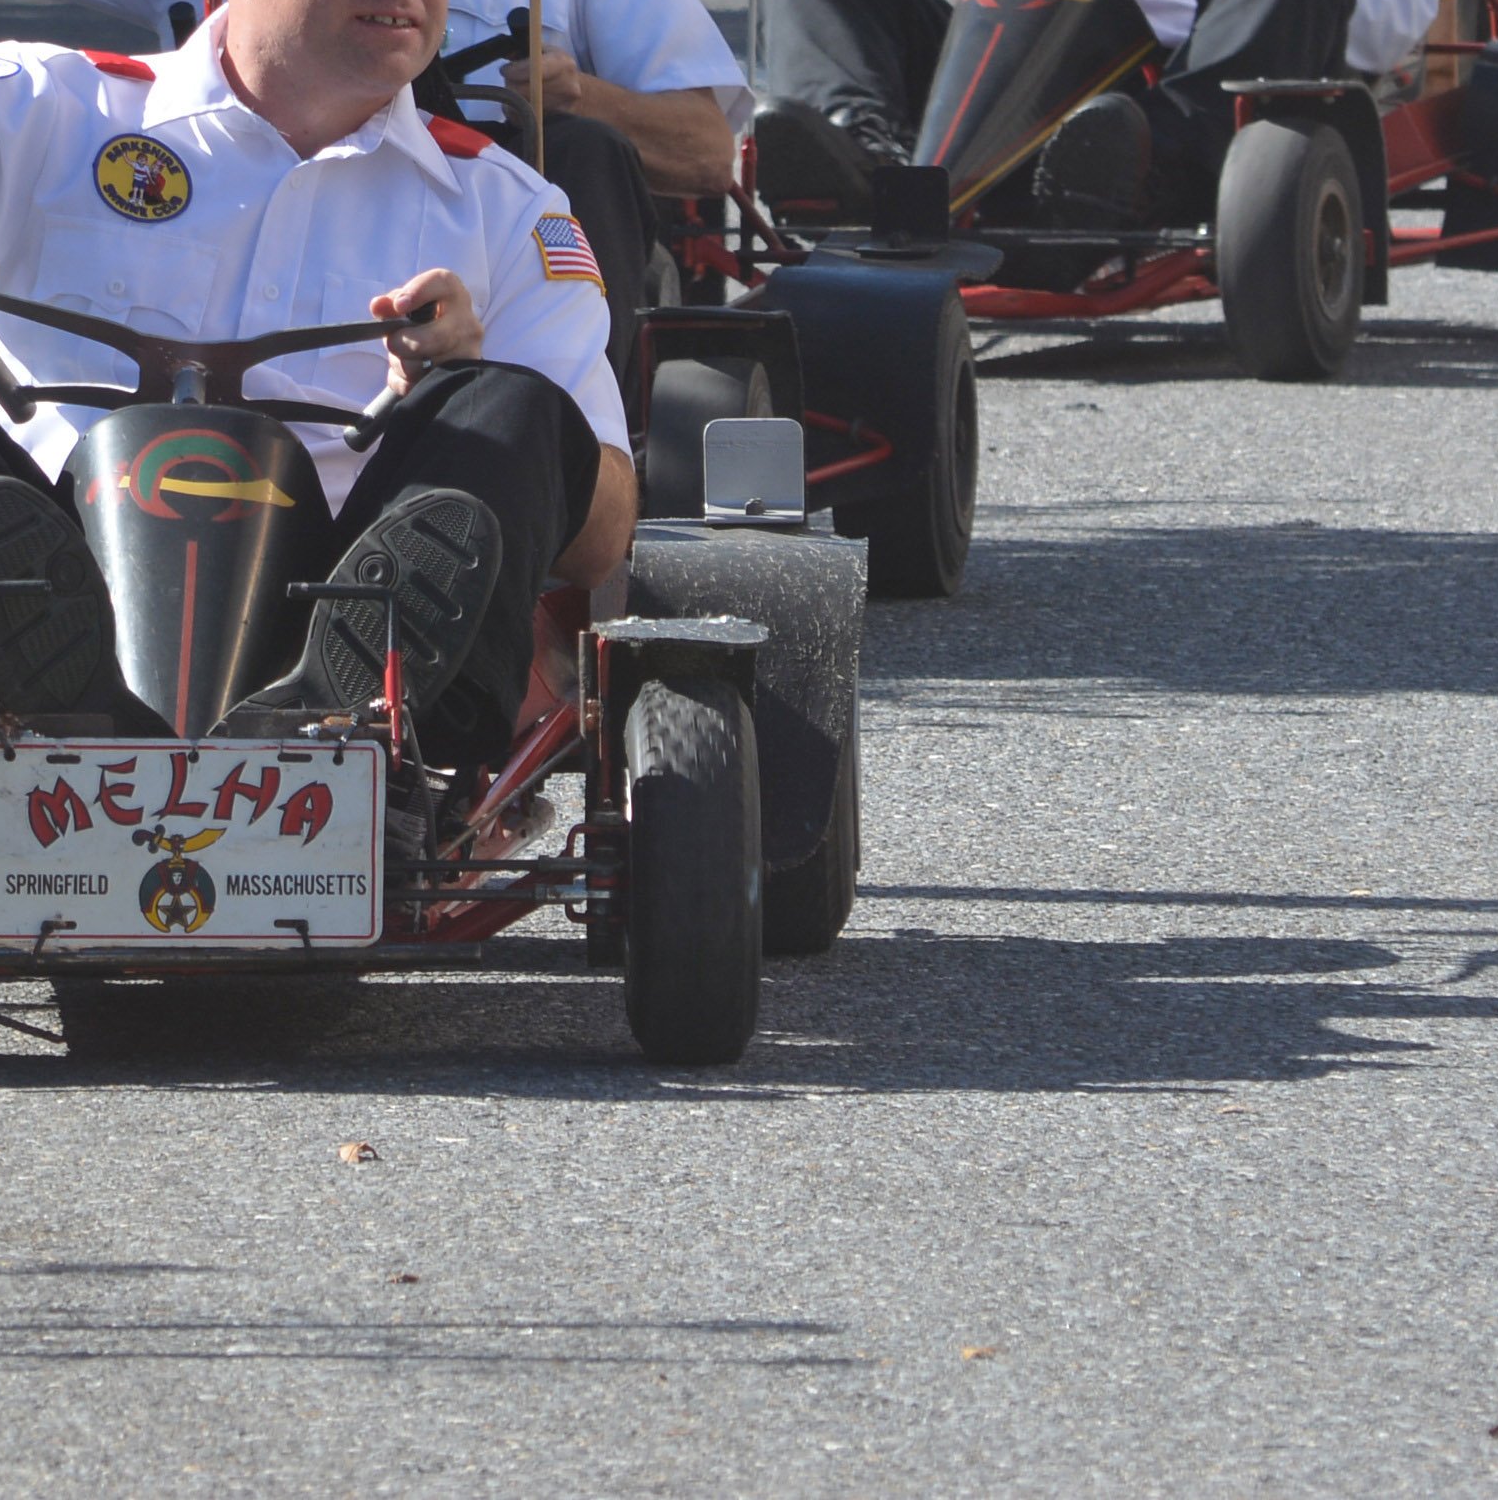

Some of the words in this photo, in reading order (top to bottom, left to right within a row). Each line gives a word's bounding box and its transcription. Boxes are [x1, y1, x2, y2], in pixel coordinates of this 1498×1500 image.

[106, 141, 182, 175] BERKSHIRE
[26, 752, 334, 848] MELHA
[5, 873, 109, 897] SPRINGFIELD
[226, 873, 368, 897] MASSACHUSETTS
